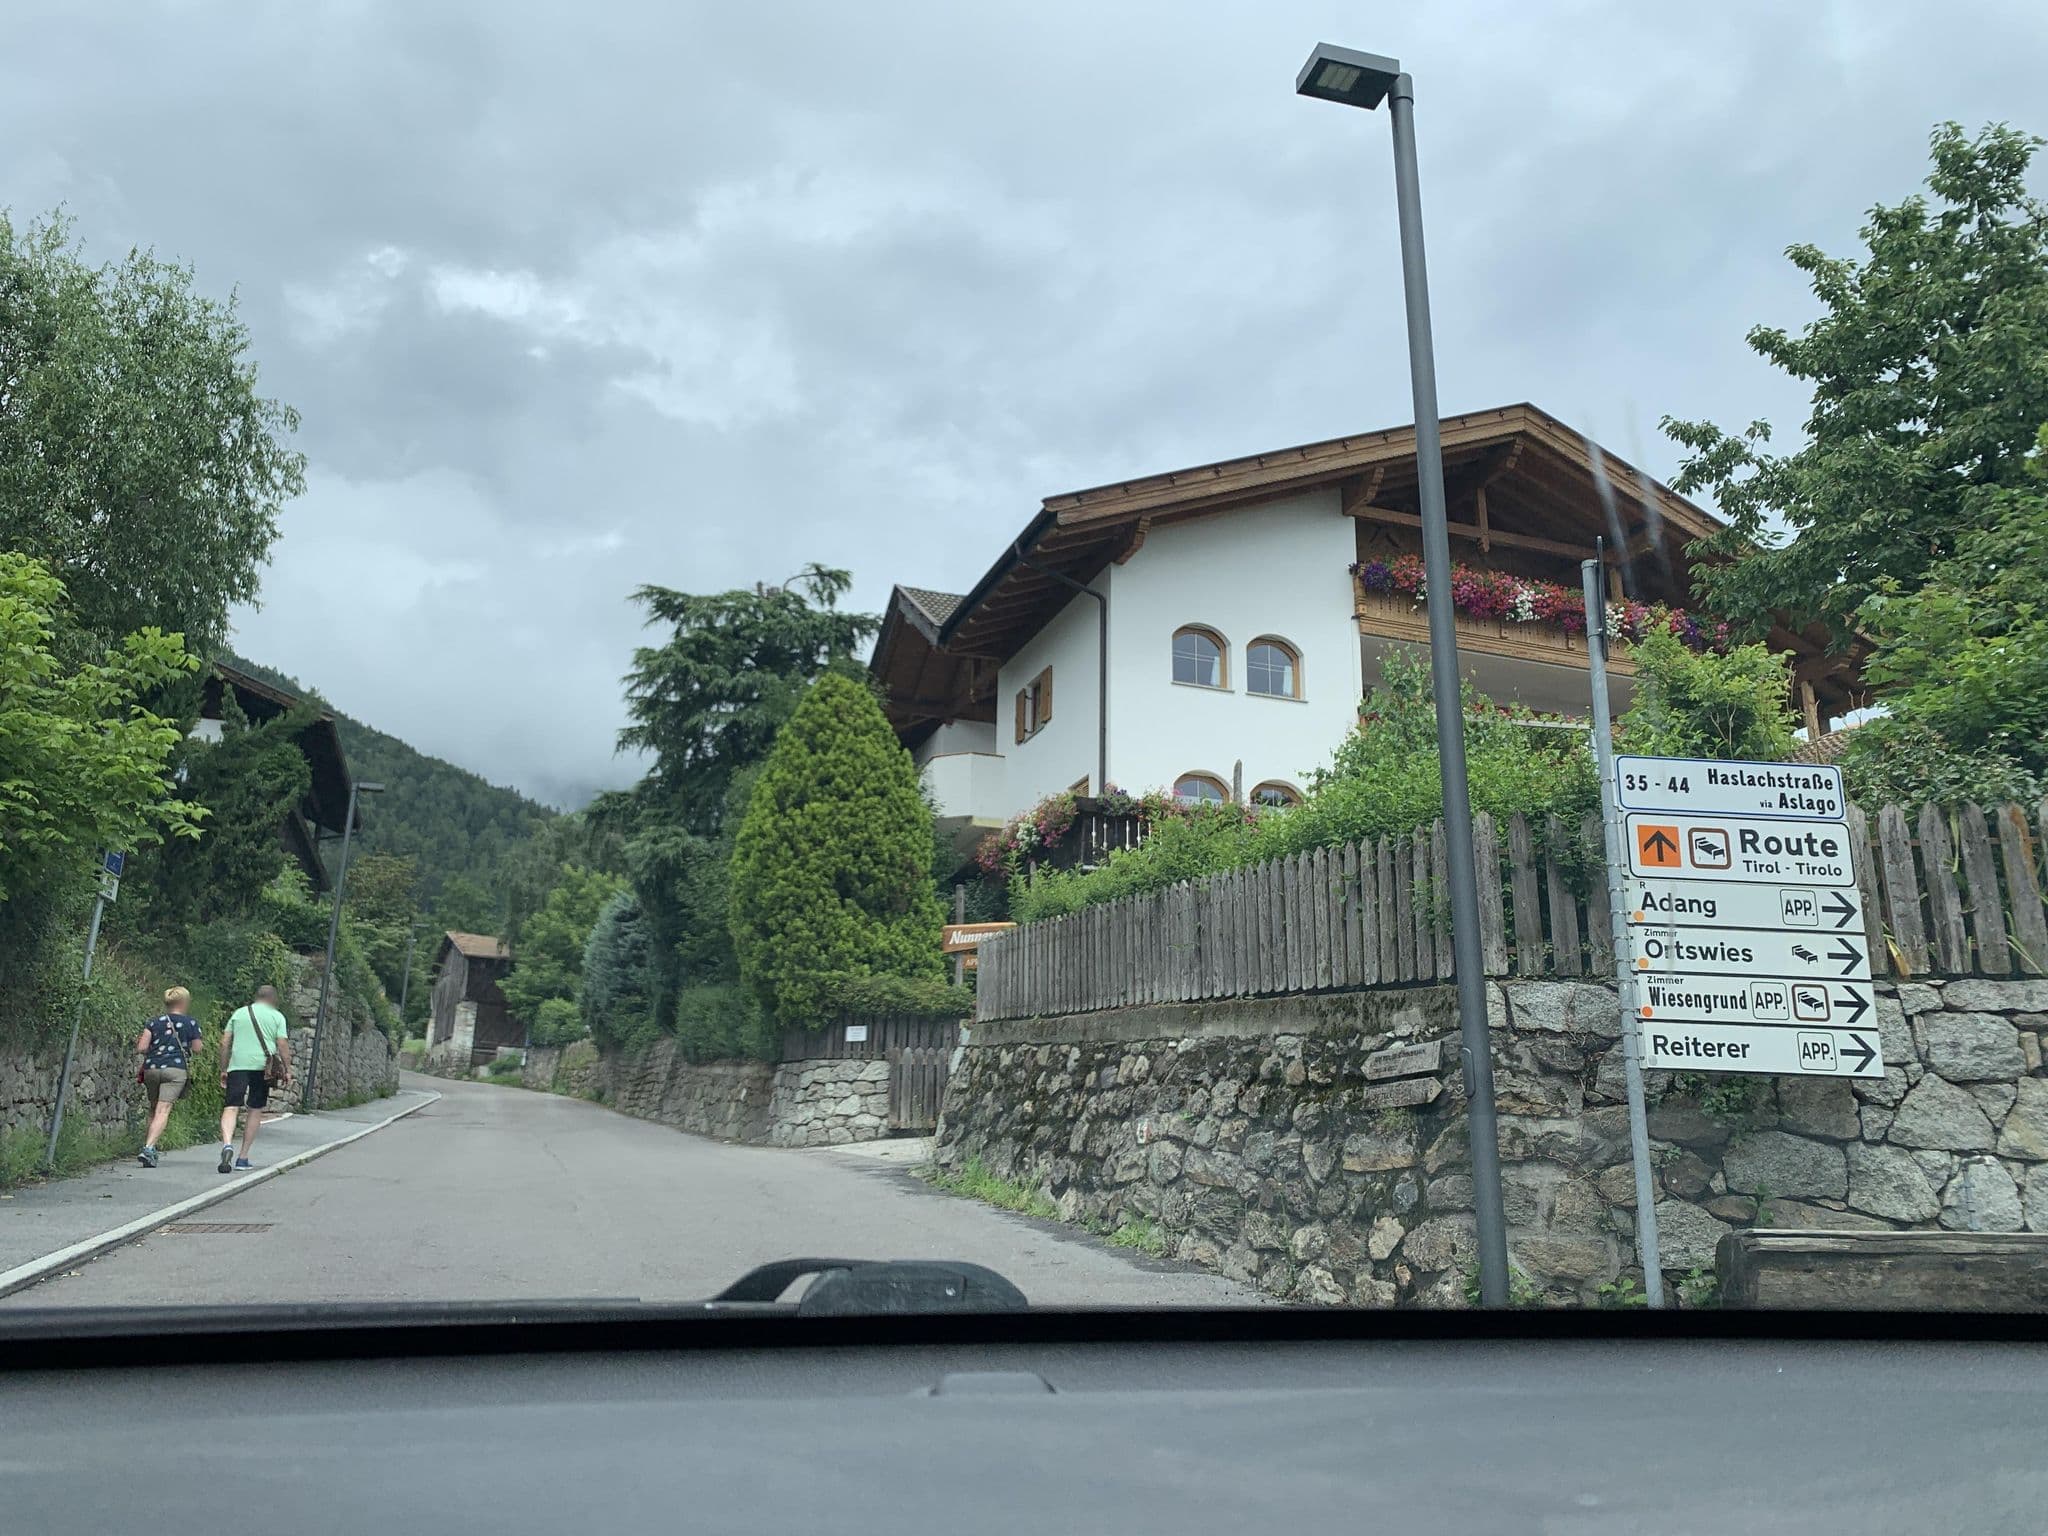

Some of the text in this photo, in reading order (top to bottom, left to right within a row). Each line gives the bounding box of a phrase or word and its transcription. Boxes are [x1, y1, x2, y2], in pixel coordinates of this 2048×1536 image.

[1625, 774, 1648, 791] 35
[1667, 776, 1690, 793] 44
[1707, 768, 1833, 790] Haslachstraße
[1760, 793, 1836, 814] via Aslago
[1739, 829, 1839, 858] Route
[1743, 860, 1780, 874] Tirol
[1796, 862, 1842, 876] Tirolo
[1641, 892, 1815, 917] Adang APP.
[1644, 928, 1677, 938] Zimmer
[1645, 939, 1753, 962] Ortswies
[1647, 975, 1684, 985] Zimmer
[1649, 986, 1786, 1013] Wiesengrund APP.
[1652, 1034, 1834, 1060] Reiterer APP.
